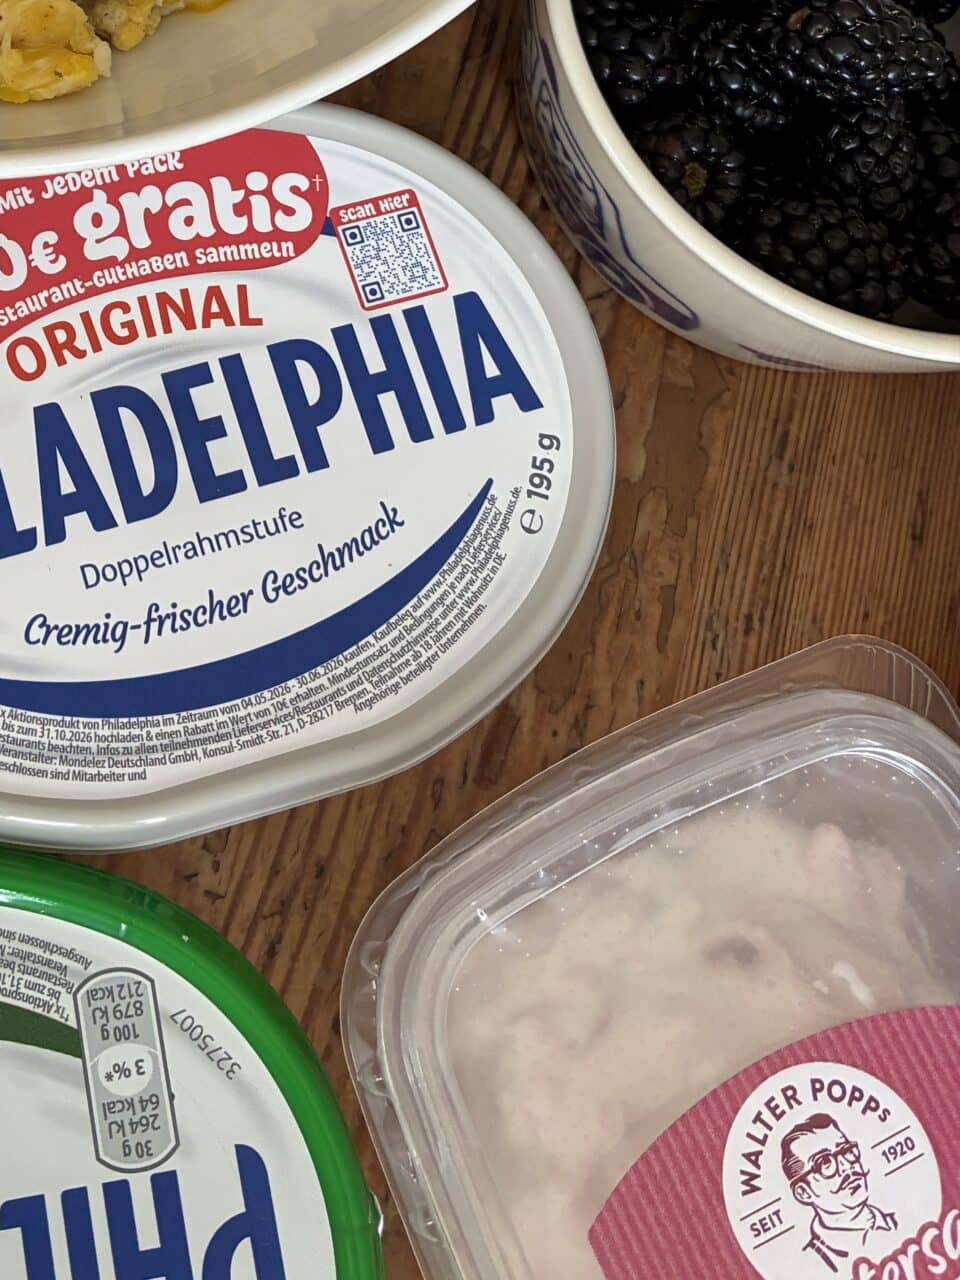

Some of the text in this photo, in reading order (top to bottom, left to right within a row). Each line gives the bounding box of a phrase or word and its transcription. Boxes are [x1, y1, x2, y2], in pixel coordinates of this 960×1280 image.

[5, 283, 264, 383] ORIGINAL
[527, 455, 556, 500] 195
[539, 433, 562, 451] g
[23, 501, 406, 654] Cremig-frischer Geschmack
[80, 508, 305, 592] Doppelrahmstufe
[1, 720, 14, 733] bis
[15, 723, 37, 738] zum
[38, 726, 92, 742] 31.10.2026
[94, 731, 144, 744] hochladen
[146, 730, 154, 741] &
[155, 728, 181, 741] einen
[183, 721, 215, 737] Rabatt
[229, 712, 253, 730] Wert
[255, 705, 271, 719] von
[271, 699, 289, 714] 10€
[329, 644, 390, 687] Mindestumsatz
[7, 708, 80, 730] Aktionsprodukt
[82, 719, 99, 731] von
[101, 716, 161, 731] Philadelphia
[162, 716, 175, 727] im
[176, 707, 219, 724] Zeitraum
[220, 703, 240, 716] vom
[241, 683, 291, 710] 04.05.2026
[296, 653, 344, 686] 30.06.2026
[343, 638, 375, 663] kaufen,
[372, 608, 412, 642] Kaufbeleg
[410, 598, 425, 613] auf
[49, 767, 70, 781] sind
[71, 770, 125, 782] Mitarbeiter
[127, 770, 147, 781] und
[353, 683, 403, 714] Angehörige
[401, 651, 441, 687] beteiligter
[438, 603, 488, 654] Unternehmen.
[59, 756, 106, 768] Mondelez
[107, 754, 167, 769] Deutschland
[169, 749, 202, 765] GmbH,
[297, 704, 334, 729] D-28217
[336, 686, 373, 713] Bremen.
[368, 657, 413, 693] Teilnahme
[429, 621, 456, 647] Jahren
[18, 931, 93, 971] Ausgeschlossen
[86, 981, 144, 1007] 212 kcal
[92, 1000, 144, 1025] 879 kJ
[101, 1022, 140, 1042] 100 g
[169, 1008, 242, 1081] 3275007
[101, 1093, 160, 1120] 64 kcal
[108, 1113, 161, 1140] 264 kJ
[740, 1084, 803, 1196] WALTER
[122, 1139, 154, 1158] 30 g
[749, 1136, 916, 1239] SEIT 1920
